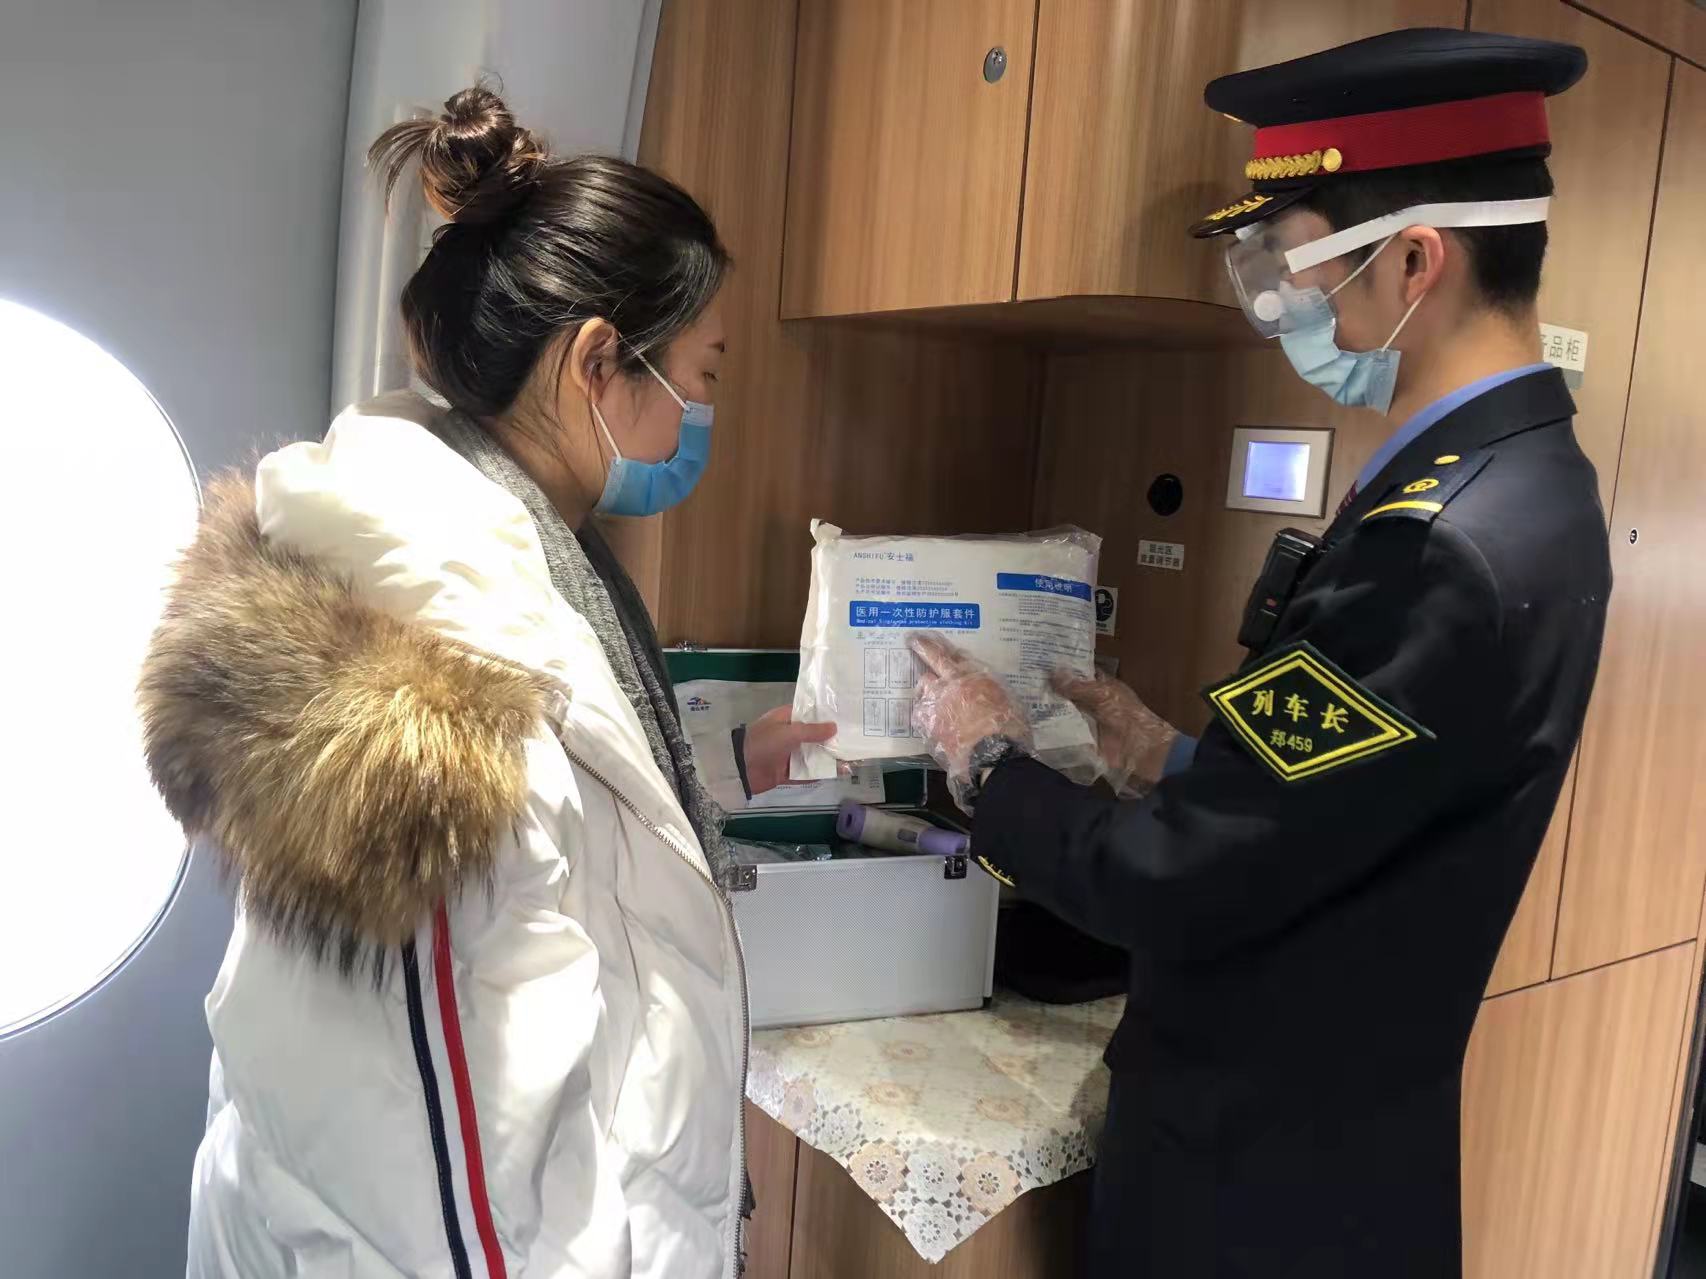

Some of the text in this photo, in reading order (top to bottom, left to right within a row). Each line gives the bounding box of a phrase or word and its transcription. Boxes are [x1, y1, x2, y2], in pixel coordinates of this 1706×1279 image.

[855, 606, 975, 619] 医用一次性防护服套件
[1251, 689, 1350, 734] 列车长
[1269, 729, 1313, 753] 郑459
